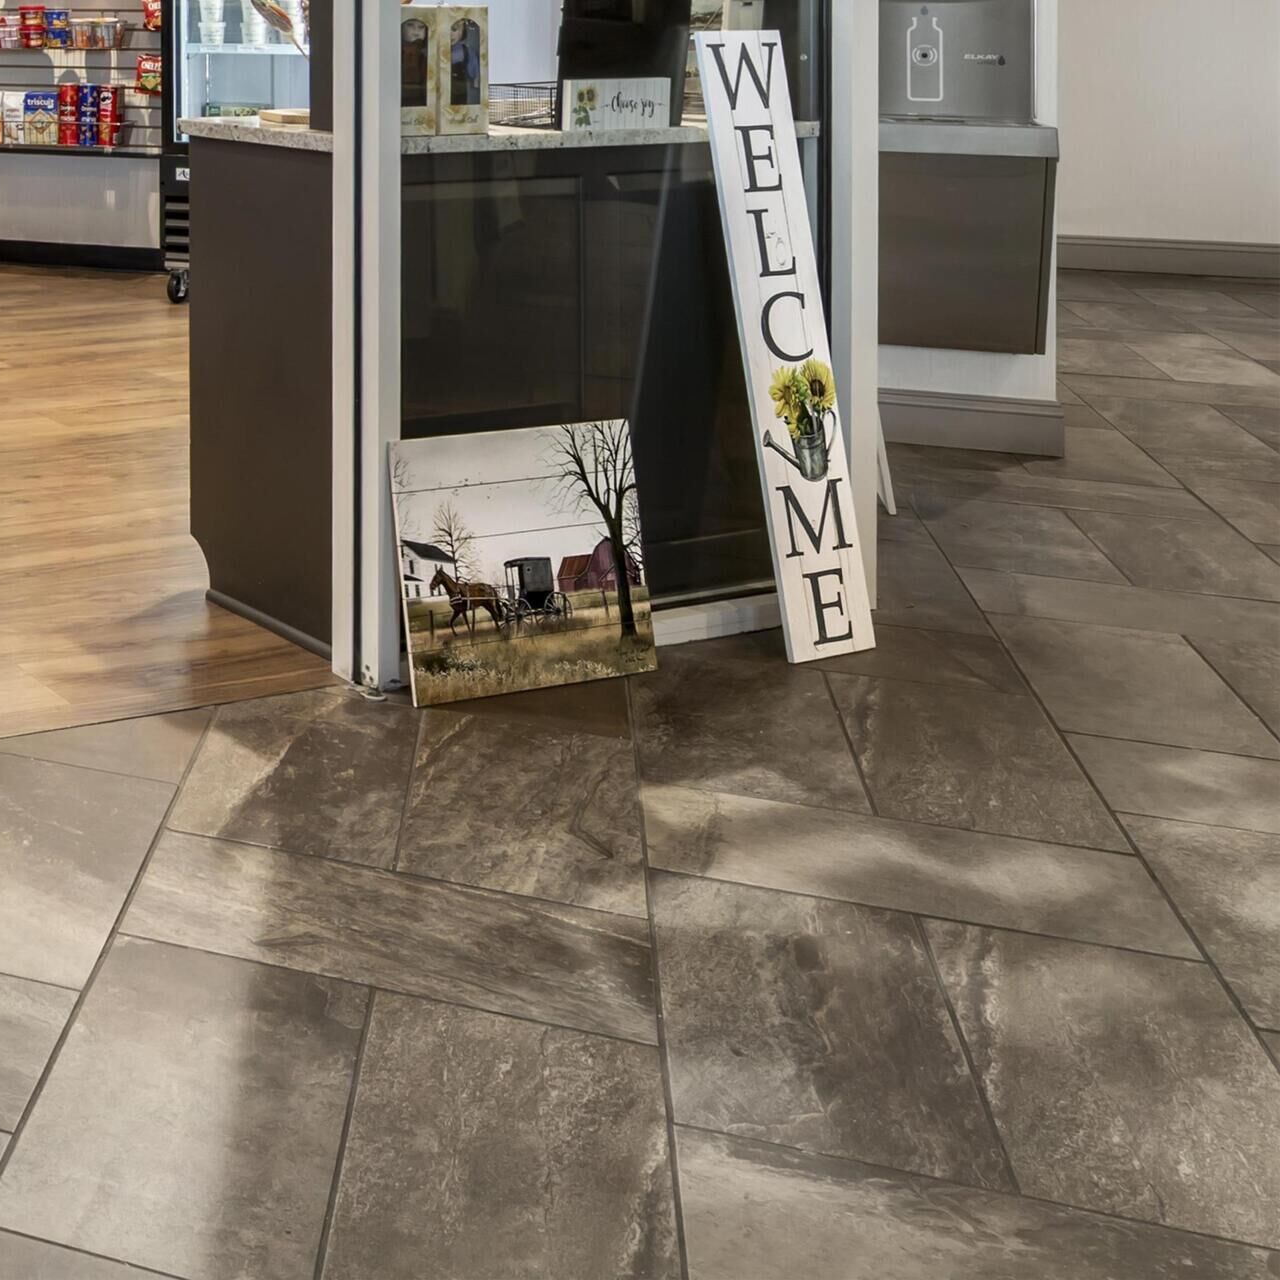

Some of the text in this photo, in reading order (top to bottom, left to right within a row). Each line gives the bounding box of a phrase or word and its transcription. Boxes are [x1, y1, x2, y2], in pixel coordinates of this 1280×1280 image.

[27, 95, 55, 107] triscuit
[610, 91, 639, 113] Choose
[706, 42, 854, 646] WELCME
